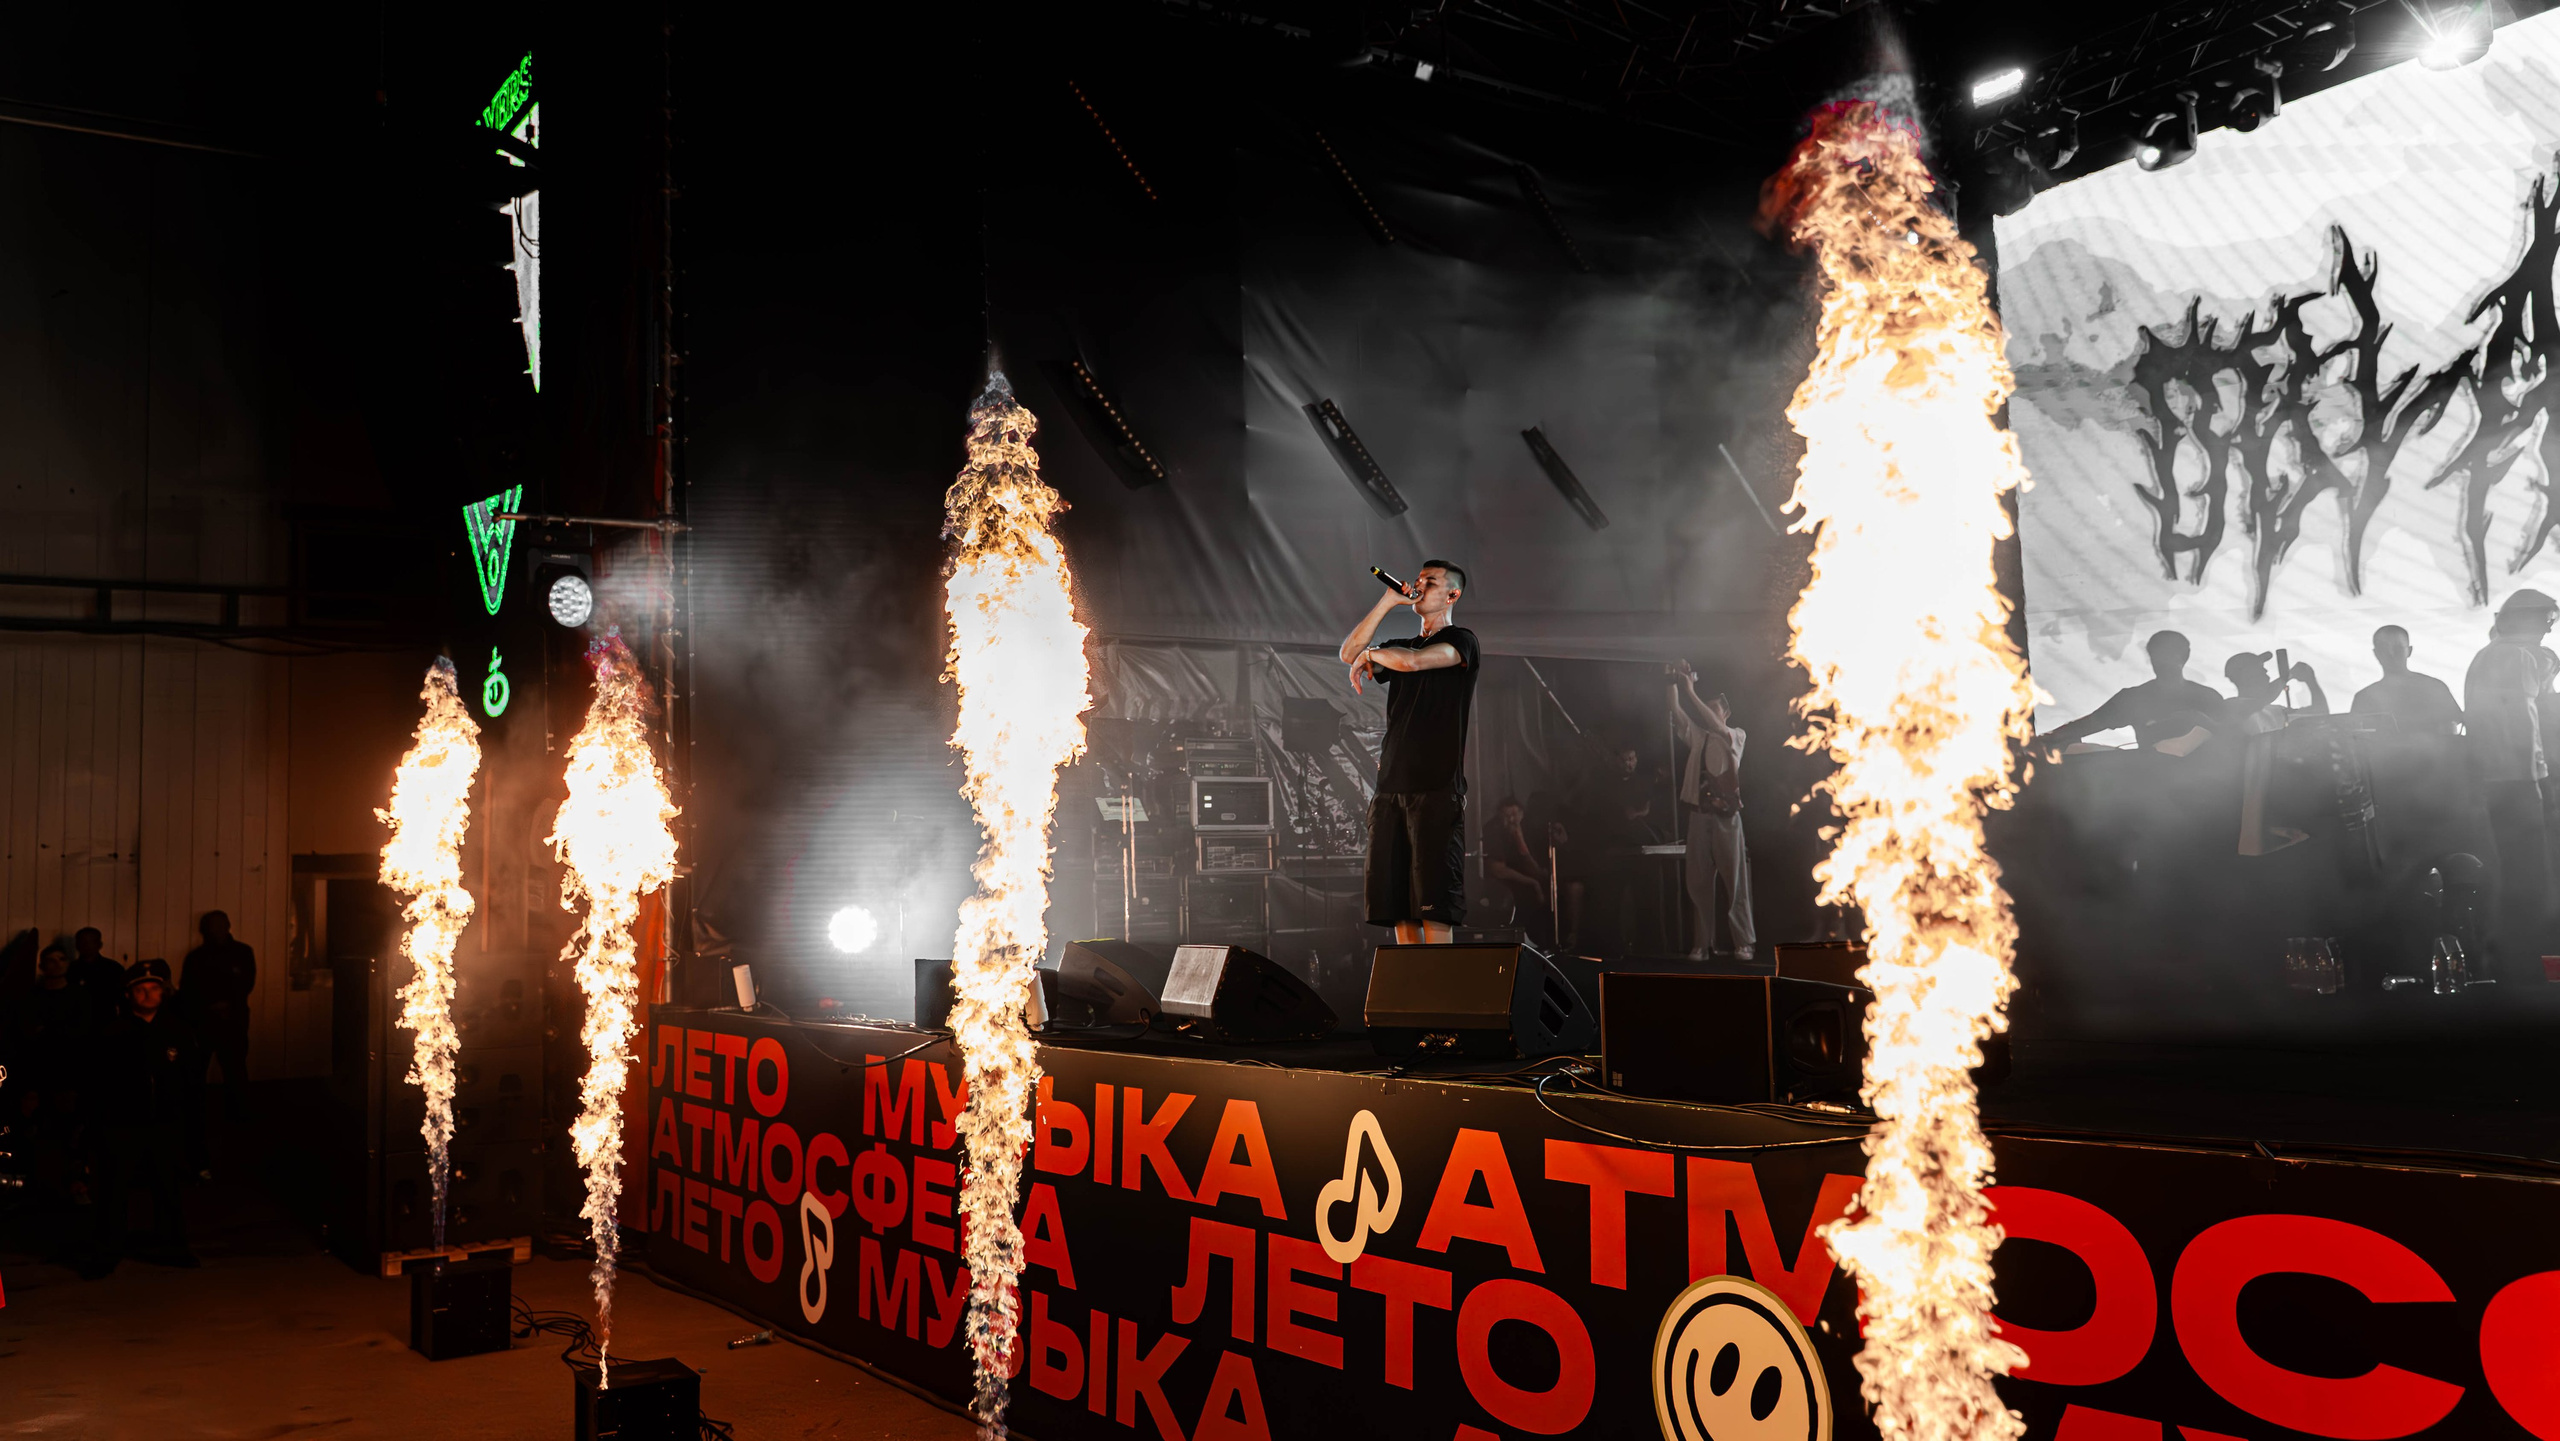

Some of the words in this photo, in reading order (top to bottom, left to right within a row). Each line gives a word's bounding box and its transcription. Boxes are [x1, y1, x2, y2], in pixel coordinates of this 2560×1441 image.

[651, 1167, 784, 1283] ЛЕТО
[651, 1024, 790, 1118] ЛЕТО
[862, 1054, 1288, 1221] МУЫКА
[1415, 1126, 2560, 1441] АТМОС
[651, 1097, 1077, 1291] АТМОСФЕА
[1171, 1215, 1597, 1435] ЛЕТО
